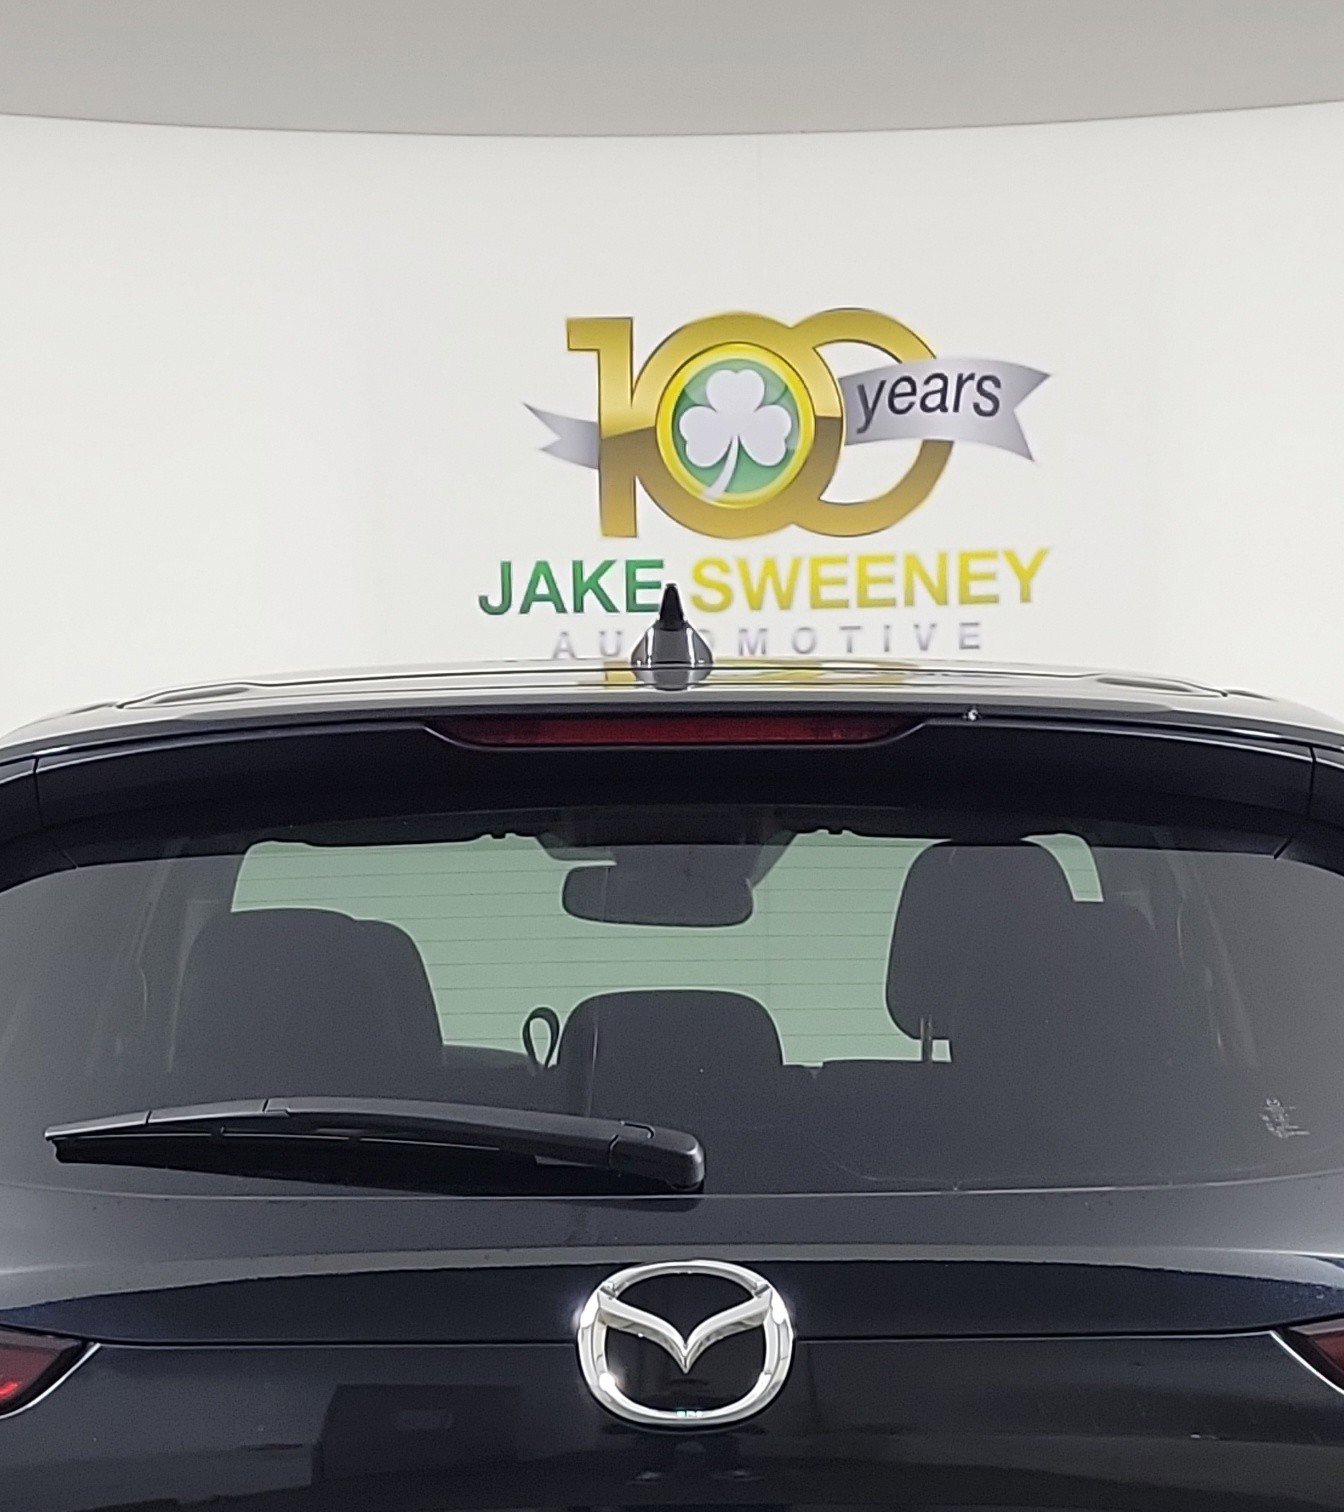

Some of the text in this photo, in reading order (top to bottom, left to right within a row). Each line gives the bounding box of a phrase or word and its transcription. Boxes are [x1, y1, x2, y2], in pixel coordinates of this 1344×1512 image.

[856, 371, 1002, 435] years
[478, 548, 1051, 616] JAKE SWEENEY
[553, 622, 983, 660] AUMOTIVE
